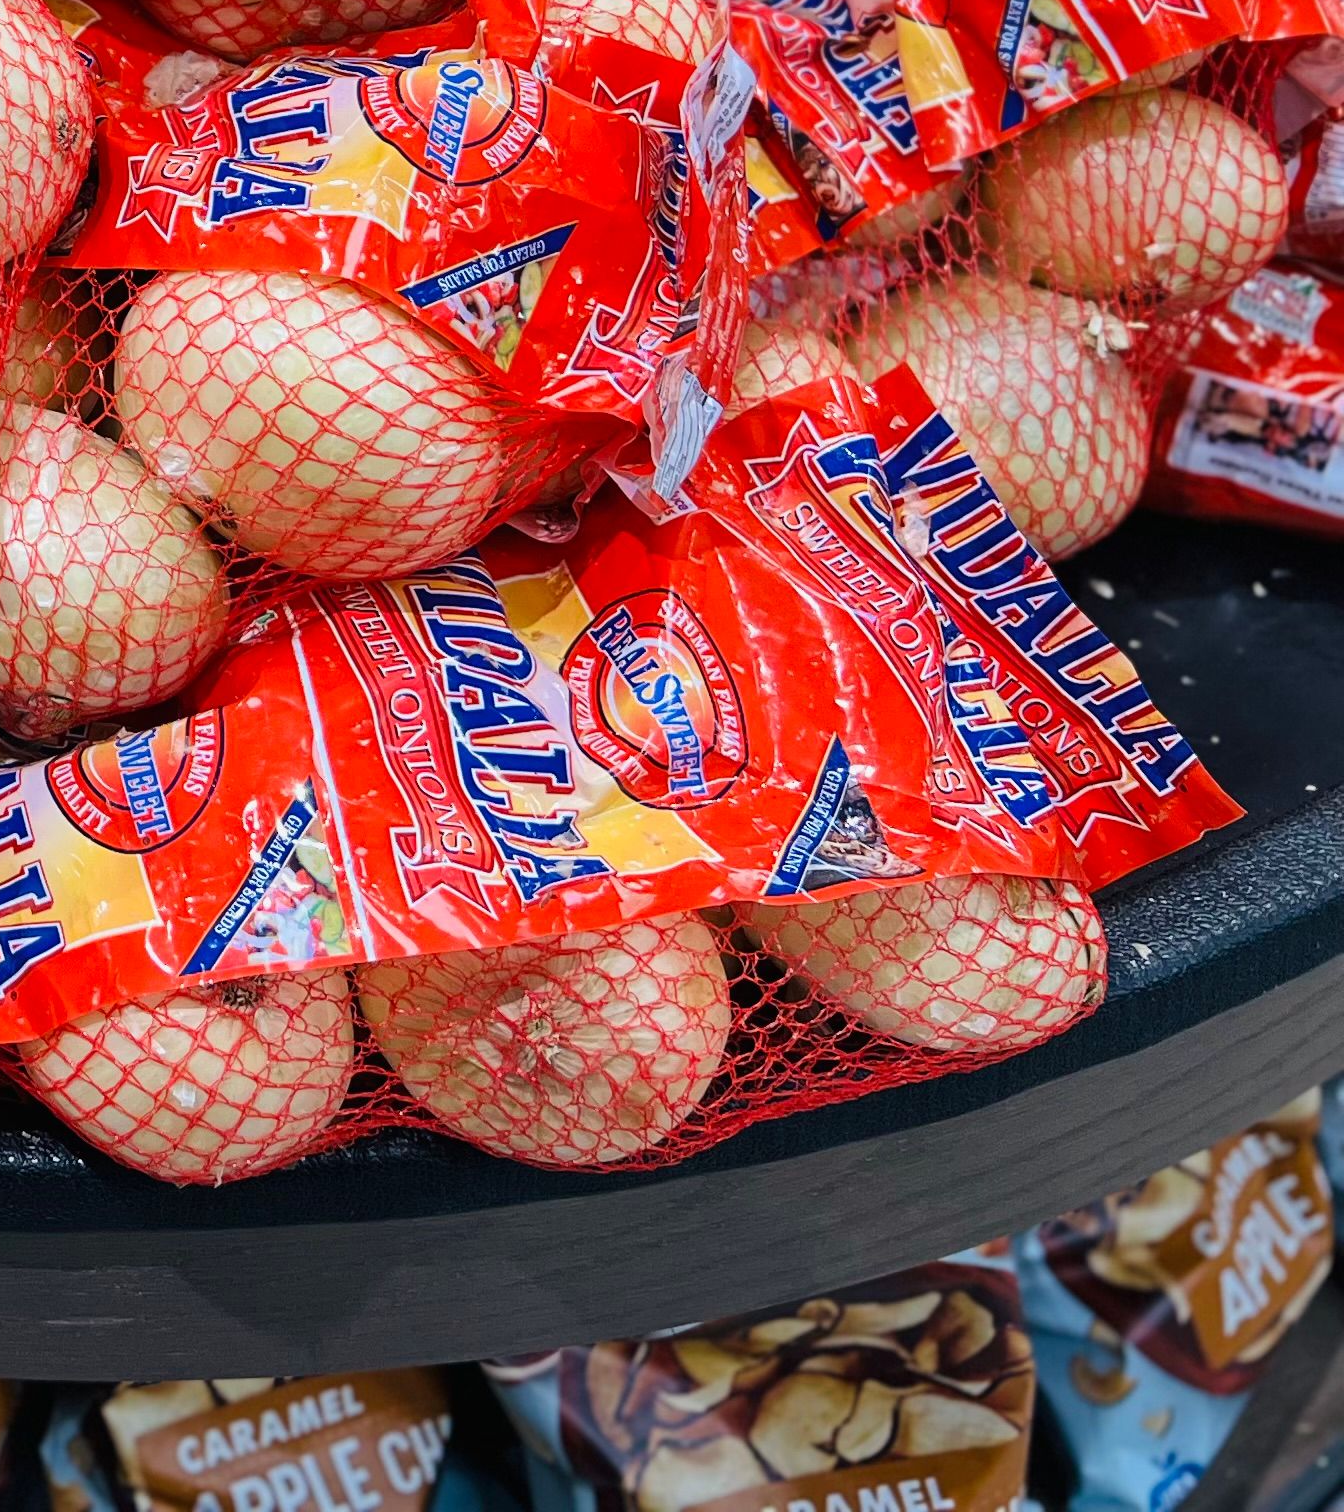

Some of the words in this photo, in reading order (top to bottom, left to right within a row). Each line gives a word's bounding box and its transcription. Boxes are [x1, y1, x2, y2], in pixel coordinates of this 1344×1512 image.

[424, 61, 485, 178] SWEET
[480, 115, 534, 168] FARMS
[436, 259, 481, 291] SALADS
[480, 252, 504, 275] FOR
[502, 238, 546, 267] GREAT
[781, 502, 908, 612] SWEET
[882, 409, 1200, 797] VIDALIA
[589, 605, 709, 800] REALSWEET
[656, 598, 725, 683] SHUMAN
[712, 687, 742, 763] FARMS
[113, 727, 174, 838] SWEET
[182, 722, 217, 798] FARMS
[388, 688, 477, 859] ONIONS
[580, 731, 650, 788] QUALITY
[813, 768, 844, 822] GREAT
[51, 764, 112, 835] QUALITY
[250, 859, 279, 890] FOR
[268, 811, 304, 873] GREAT
[213, 887, 256, 938] SALADS
[1219, 1173, 1328, 1338] APPLE
[174, 1383, 367, 1476] CARAMEL
